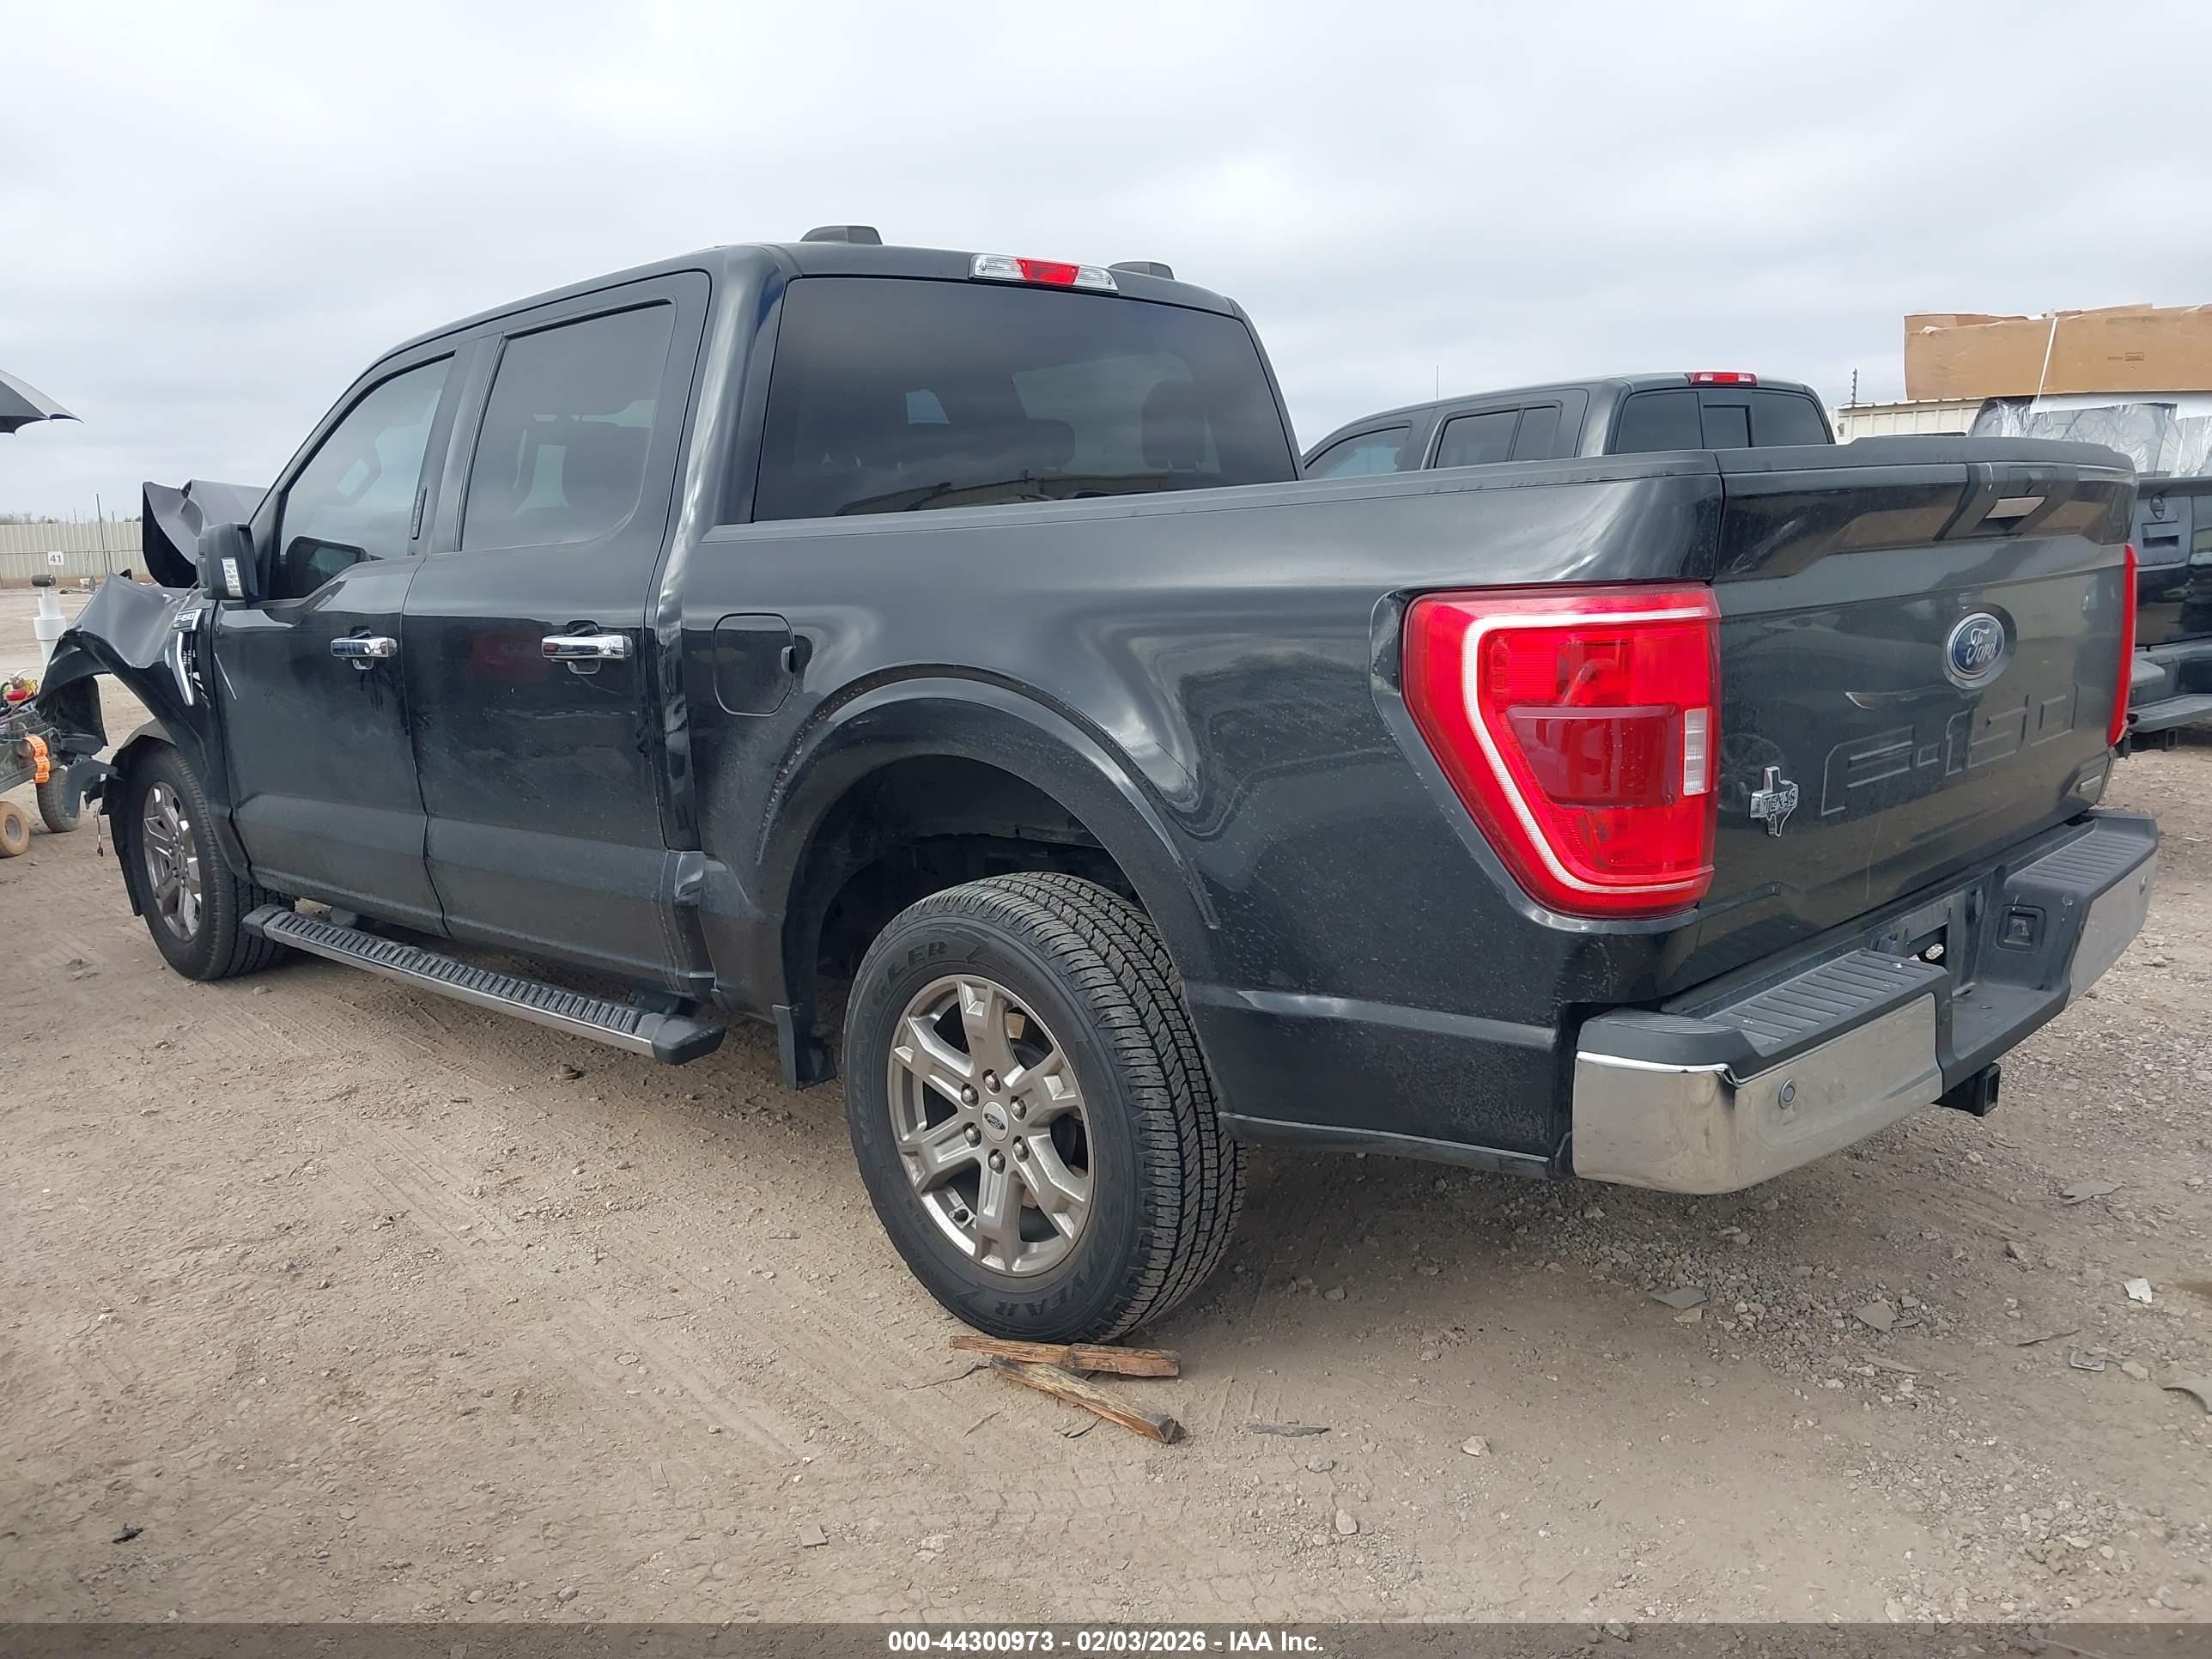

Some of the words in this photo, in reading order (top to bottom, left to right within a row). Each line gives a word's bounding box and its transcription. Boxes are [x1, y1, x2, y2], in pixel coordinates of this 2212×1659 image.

[50, 554, 61, 563] 41
[1966, 628, 1998, 665] Ford
[1820, 679, 2081, 817] F-150
[1764, 789, 1796, 814] TEXAS
